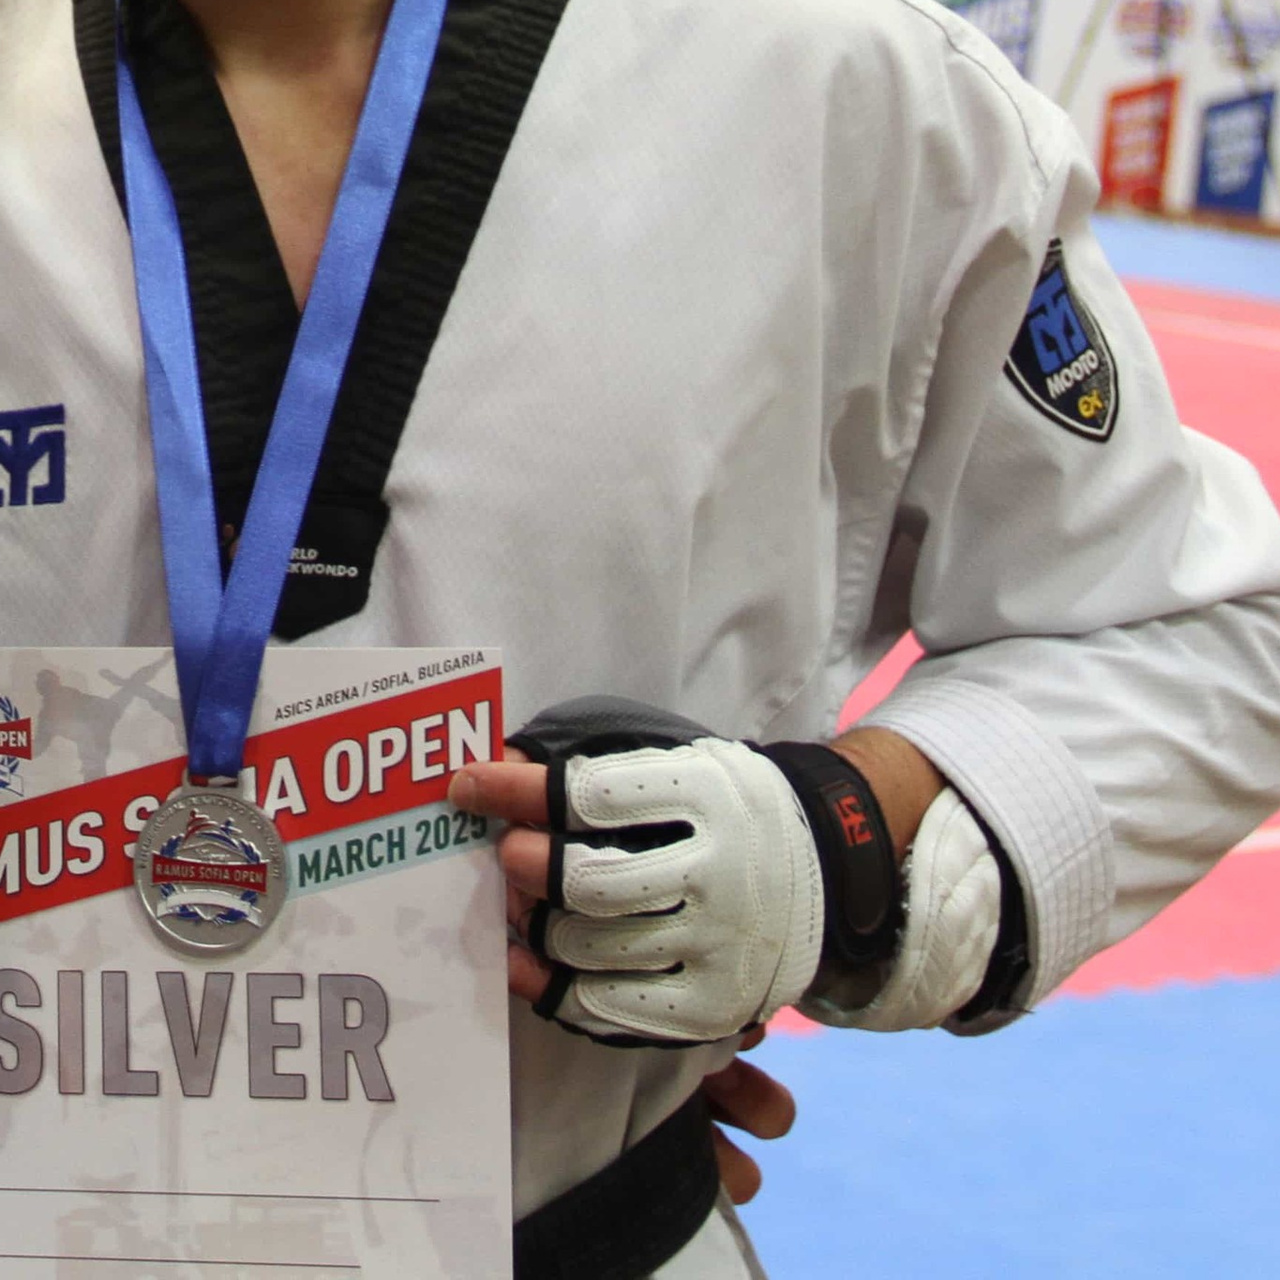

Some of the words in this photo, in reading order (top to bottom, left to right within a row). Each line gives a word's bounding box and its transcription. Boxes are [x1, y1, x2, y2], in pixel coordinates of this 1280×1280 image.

[1045, 349, 1100, 400] MOOTO
[287, 562, 358, 577] KWONDO
[290, 548, 318, 560] RLD
[274, 699, 313, 721] ASICS
[315, 687, 359, 711] ARENA
[371, 671, 414, 694] SOFIA,
[417, 650, 485, 680] BULGARIA
[322, 699, 491, 803] OPEN
[155, 863, 195, 878] RAMUS
[199, 866, 231, 880] SOFIA
[234, 869, 264, 884] OPEN
[298, 826, 406, 888] MARCH
